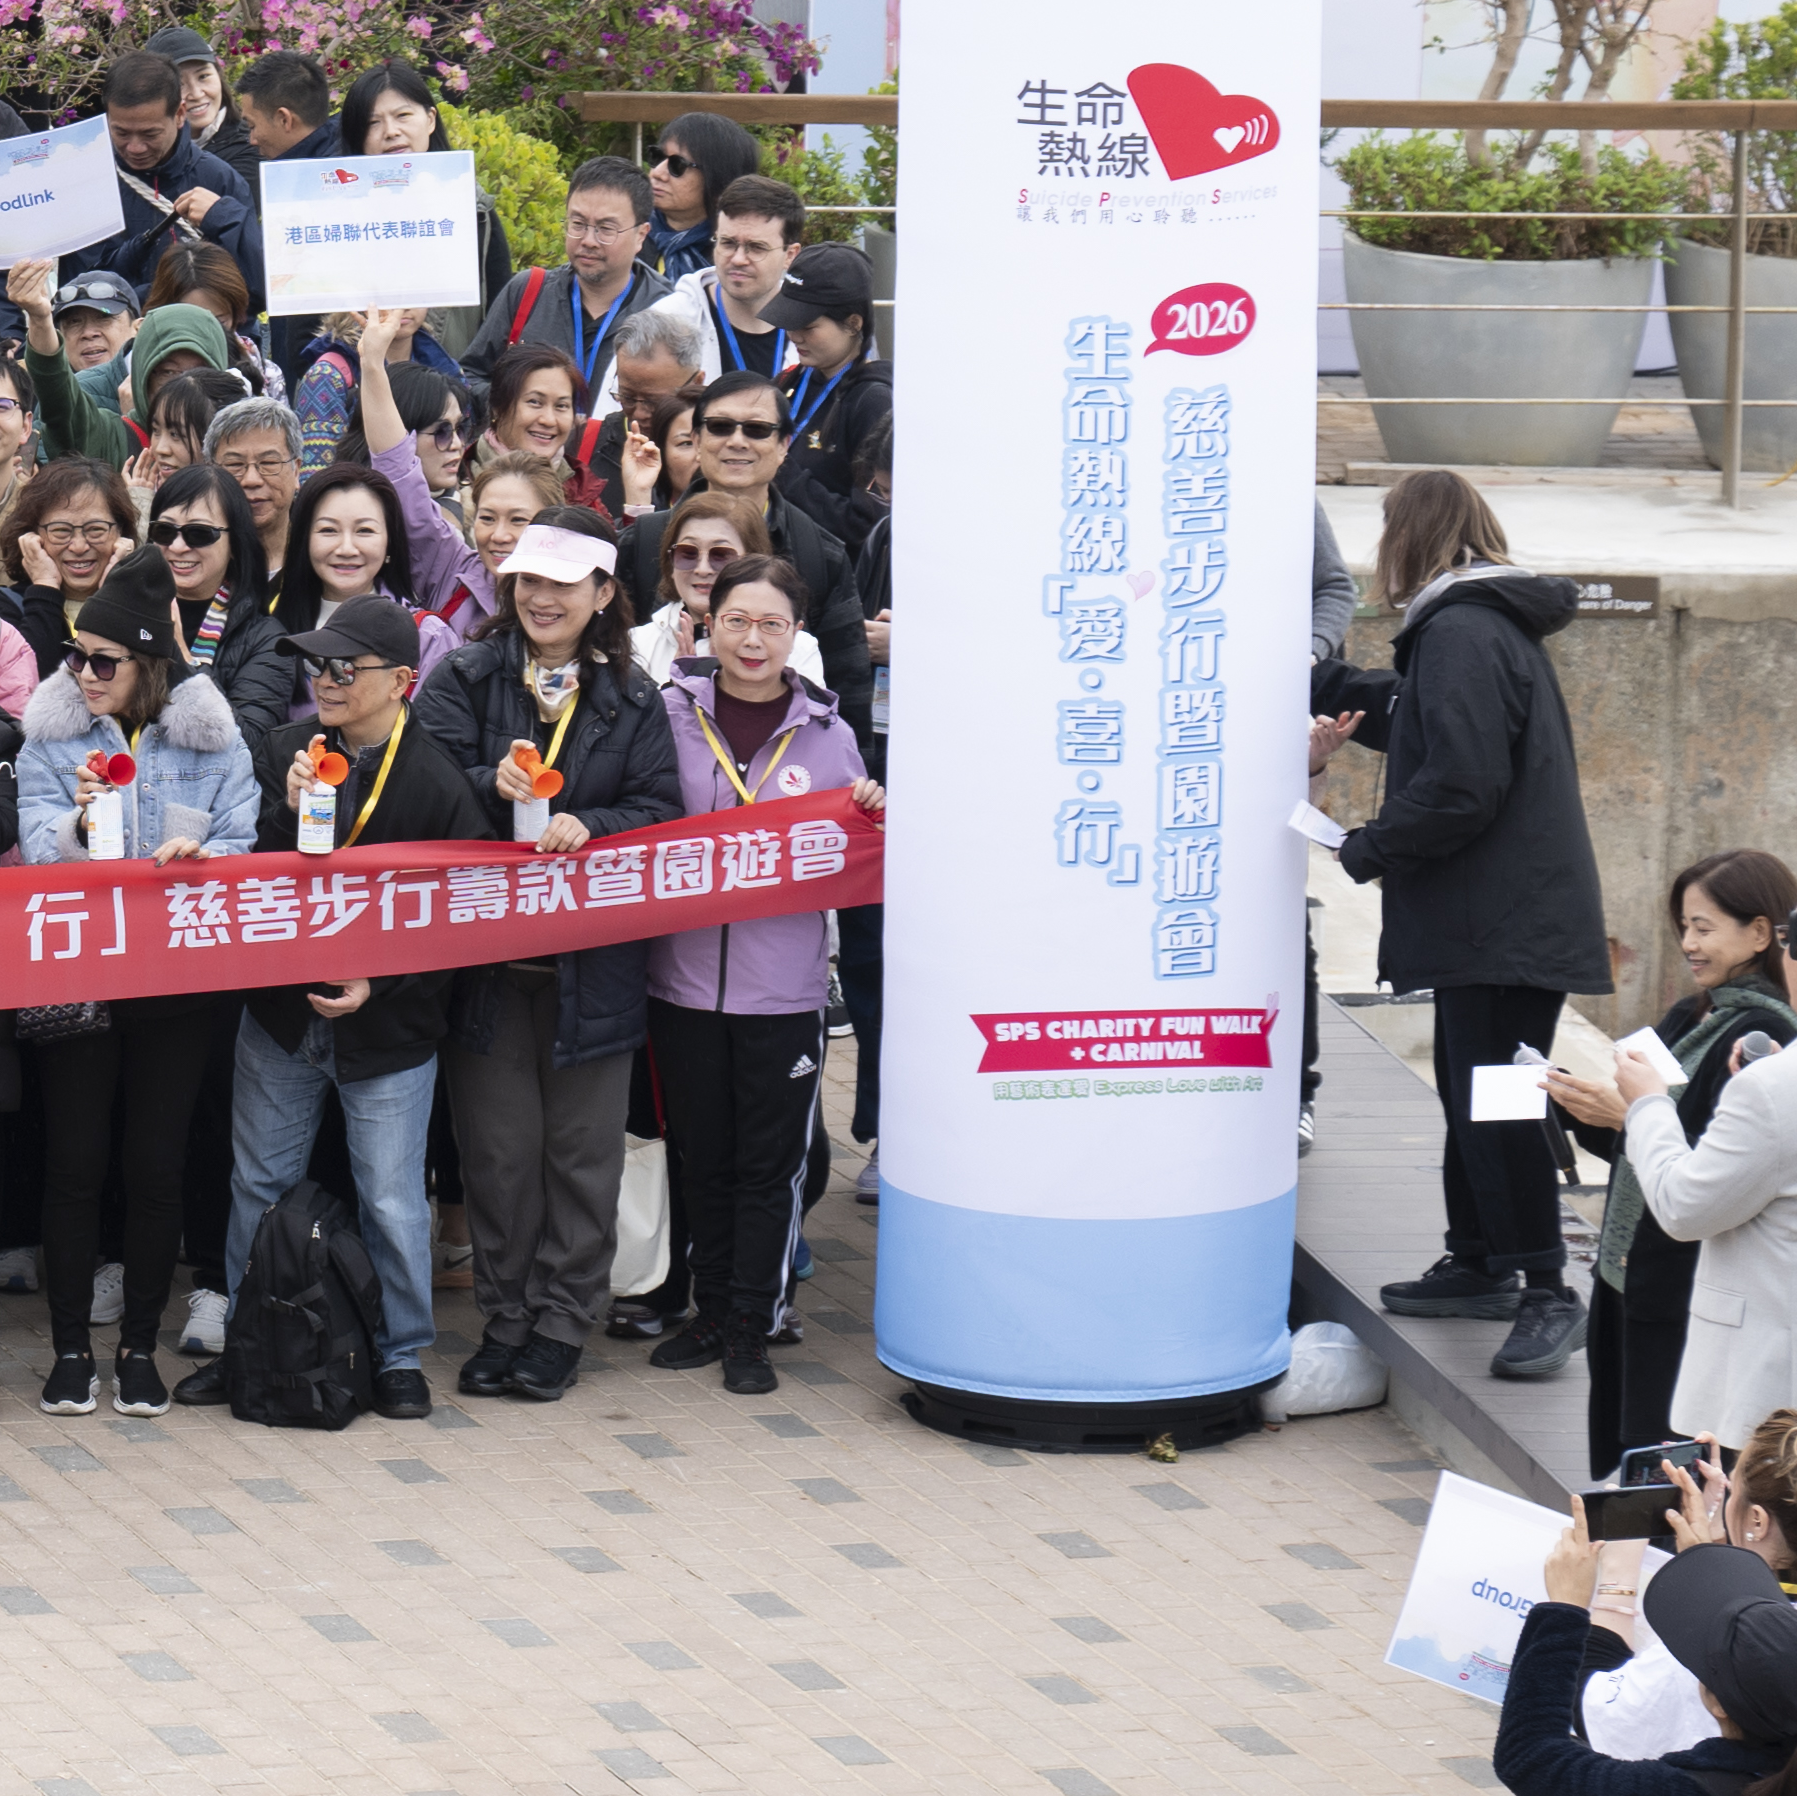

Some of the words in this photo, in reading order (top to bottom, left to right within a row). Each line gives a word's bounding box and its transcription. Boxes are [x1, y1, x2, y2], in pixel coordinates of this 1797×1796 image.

[1016, 79, 1128, 129] 生命
[1037, 130, 1151, 179] 熱線
[1018, 187, 1094, 207] Suicide
[1098, 190, 1207, 210] Prevention
[1211, 183, 1278, 206] Services
[284, 218, 456, 245] 港區婦聯代表聯誼會
[1165, 298, 1248, 340] 2026
[1614, 599, 1653, 613] Danger
[1157, 389, 1229, 978] 慈善步行暨園遊會
[995, 1023, 1041, 1043] SPS
[1047, 1017, 1155, 1040] CHARITY
[1160, 1016, 1206, 1038] FUN
[1211, 1015, 1263, 1036] WALK
[1070, 1047, 1085, 1061] +
[1090, 1041, 1204, 1063] CARNIVAL
[1095, 1077, 1164, 1096] Express
[1166, 1076, 1207, 1094] Love
[1209, 1075, 1241, 1093] with
[1242, 1076, 1263, 1092] Art
[1472, 1577, 1534, 1620] Group
